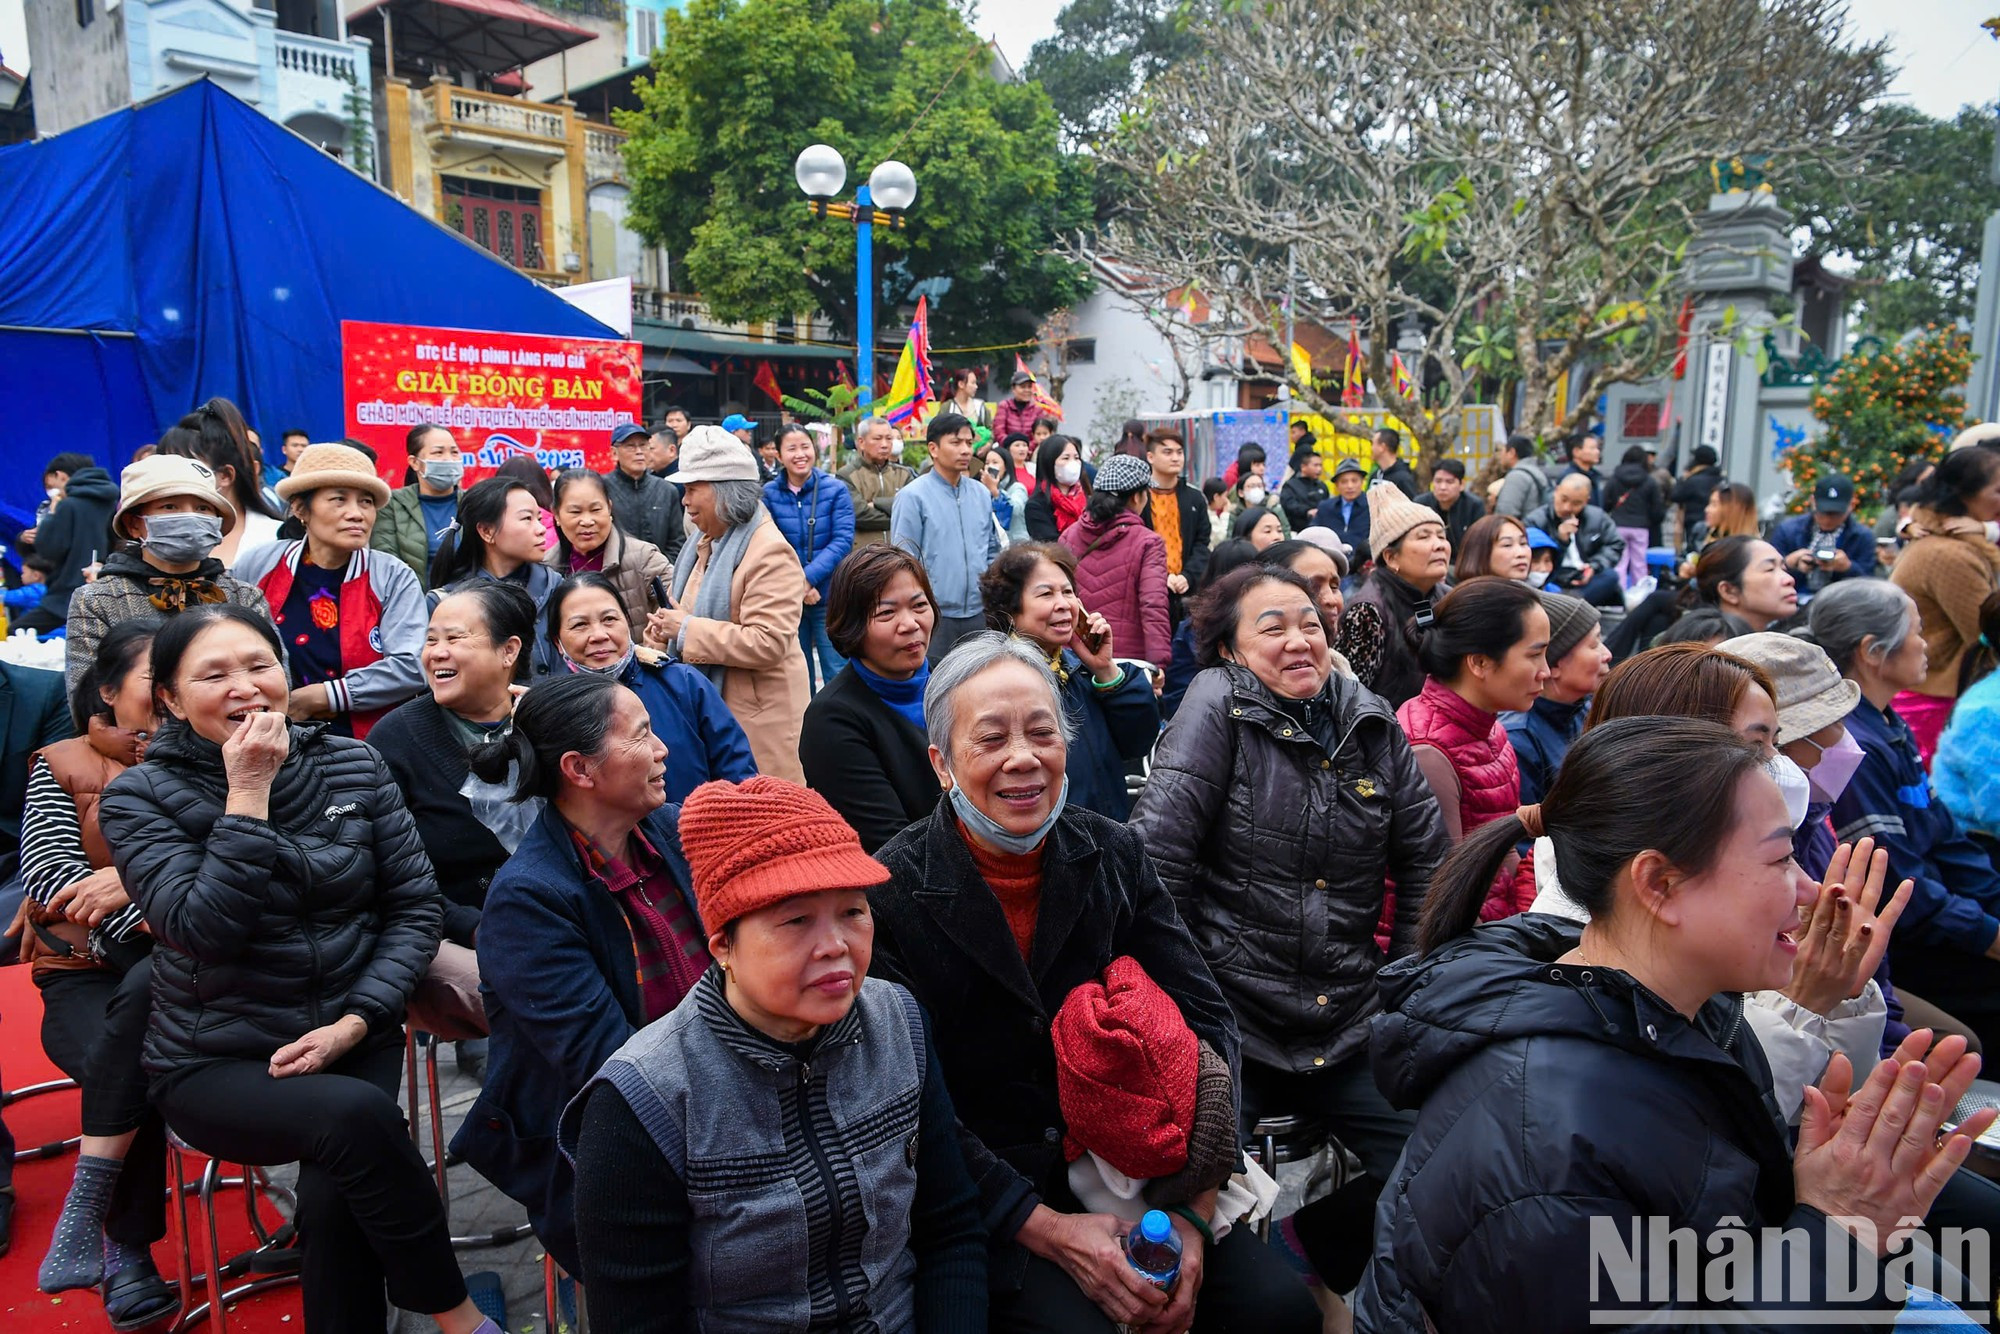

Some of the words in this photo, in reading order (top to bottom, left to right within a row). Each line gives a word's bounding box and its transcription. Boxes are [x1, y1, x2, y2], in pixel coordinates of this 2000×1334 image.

[416, 344, 440, 360] BTC
[459, 345, 479, 365] HỘI
[481, 346, 509, 364] ĐÌNH
[511, 348, 541, 366] LÀNG
[397, 363, 459, 394] GIẢI
[468, 370, 545, 397] BÓNG
[552, 375, 603, 399] BÀN
[357, 399, 396, 424] CHÀO
[535, 449, 585, 469] 2025
